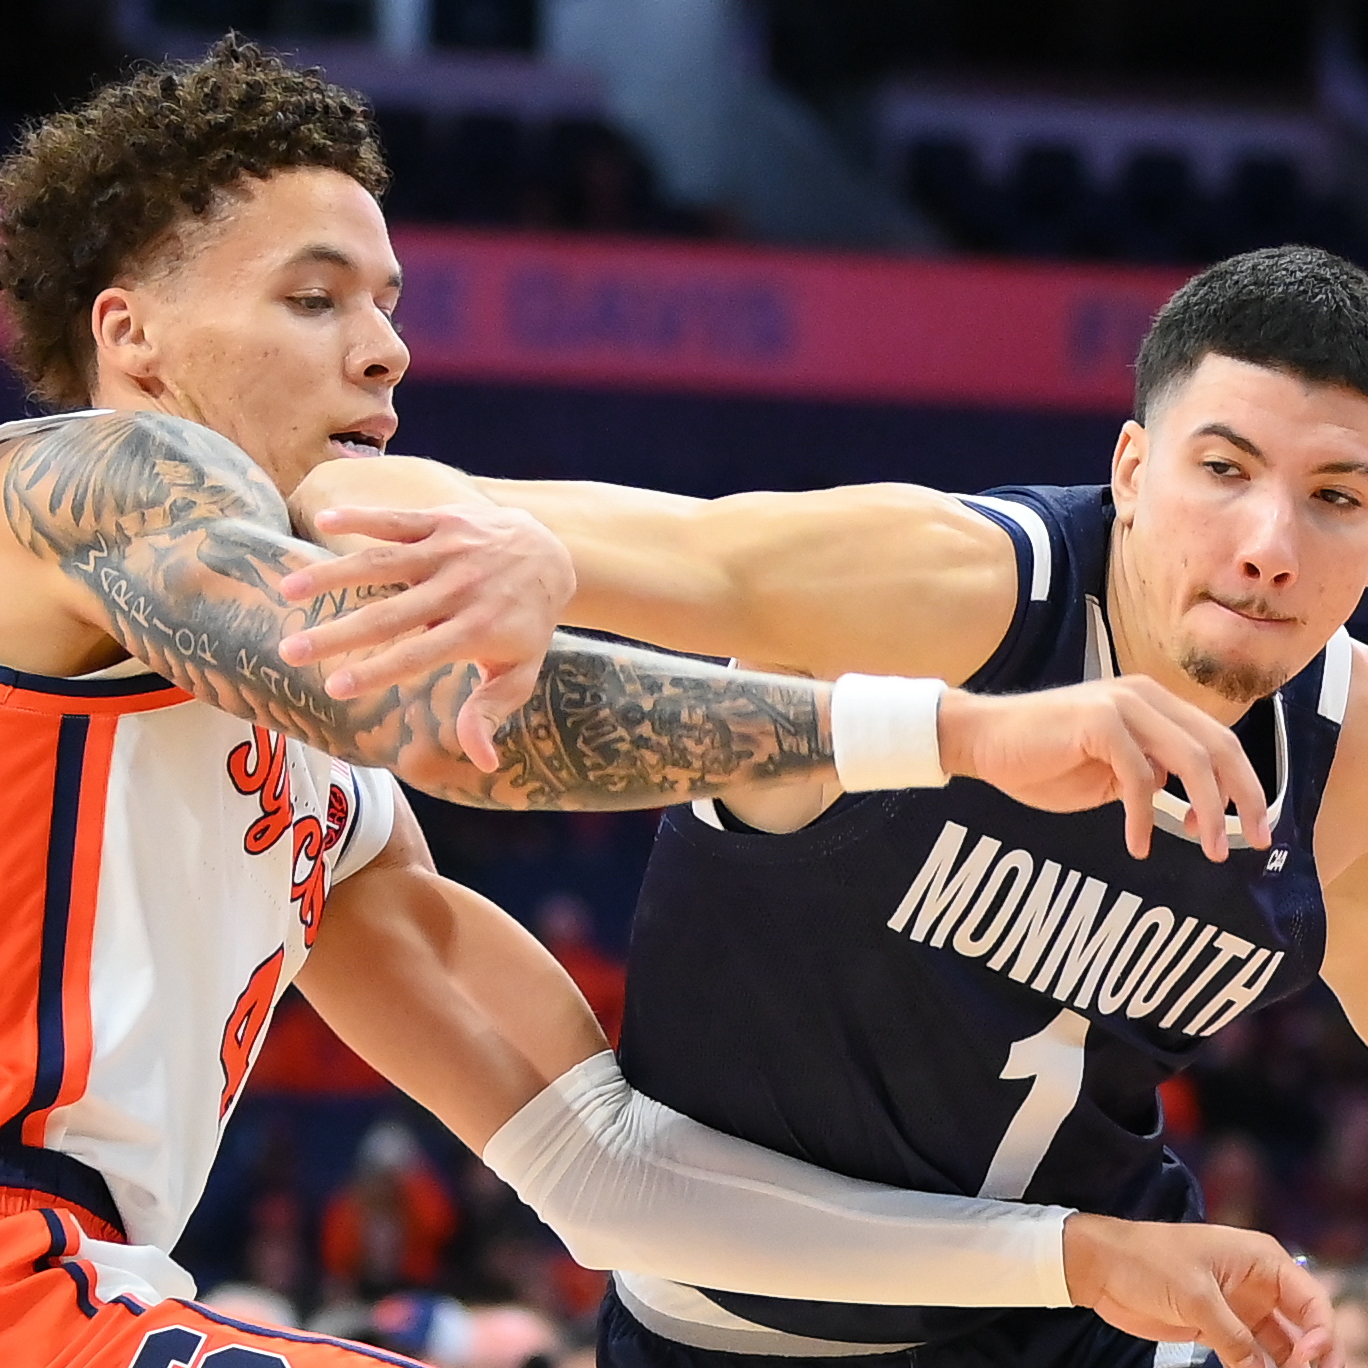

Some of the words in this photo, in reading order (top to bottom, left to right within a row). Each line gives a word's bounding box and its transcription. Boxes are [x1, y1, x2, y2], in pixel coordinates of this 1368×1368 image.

[71, 531, 219, 666] WARRIOR
[235, 647, 336, 727] RACE
[886, 819, 1285, 1038] MONMOUTH
[977, 1006, 1092, 1200] 1
